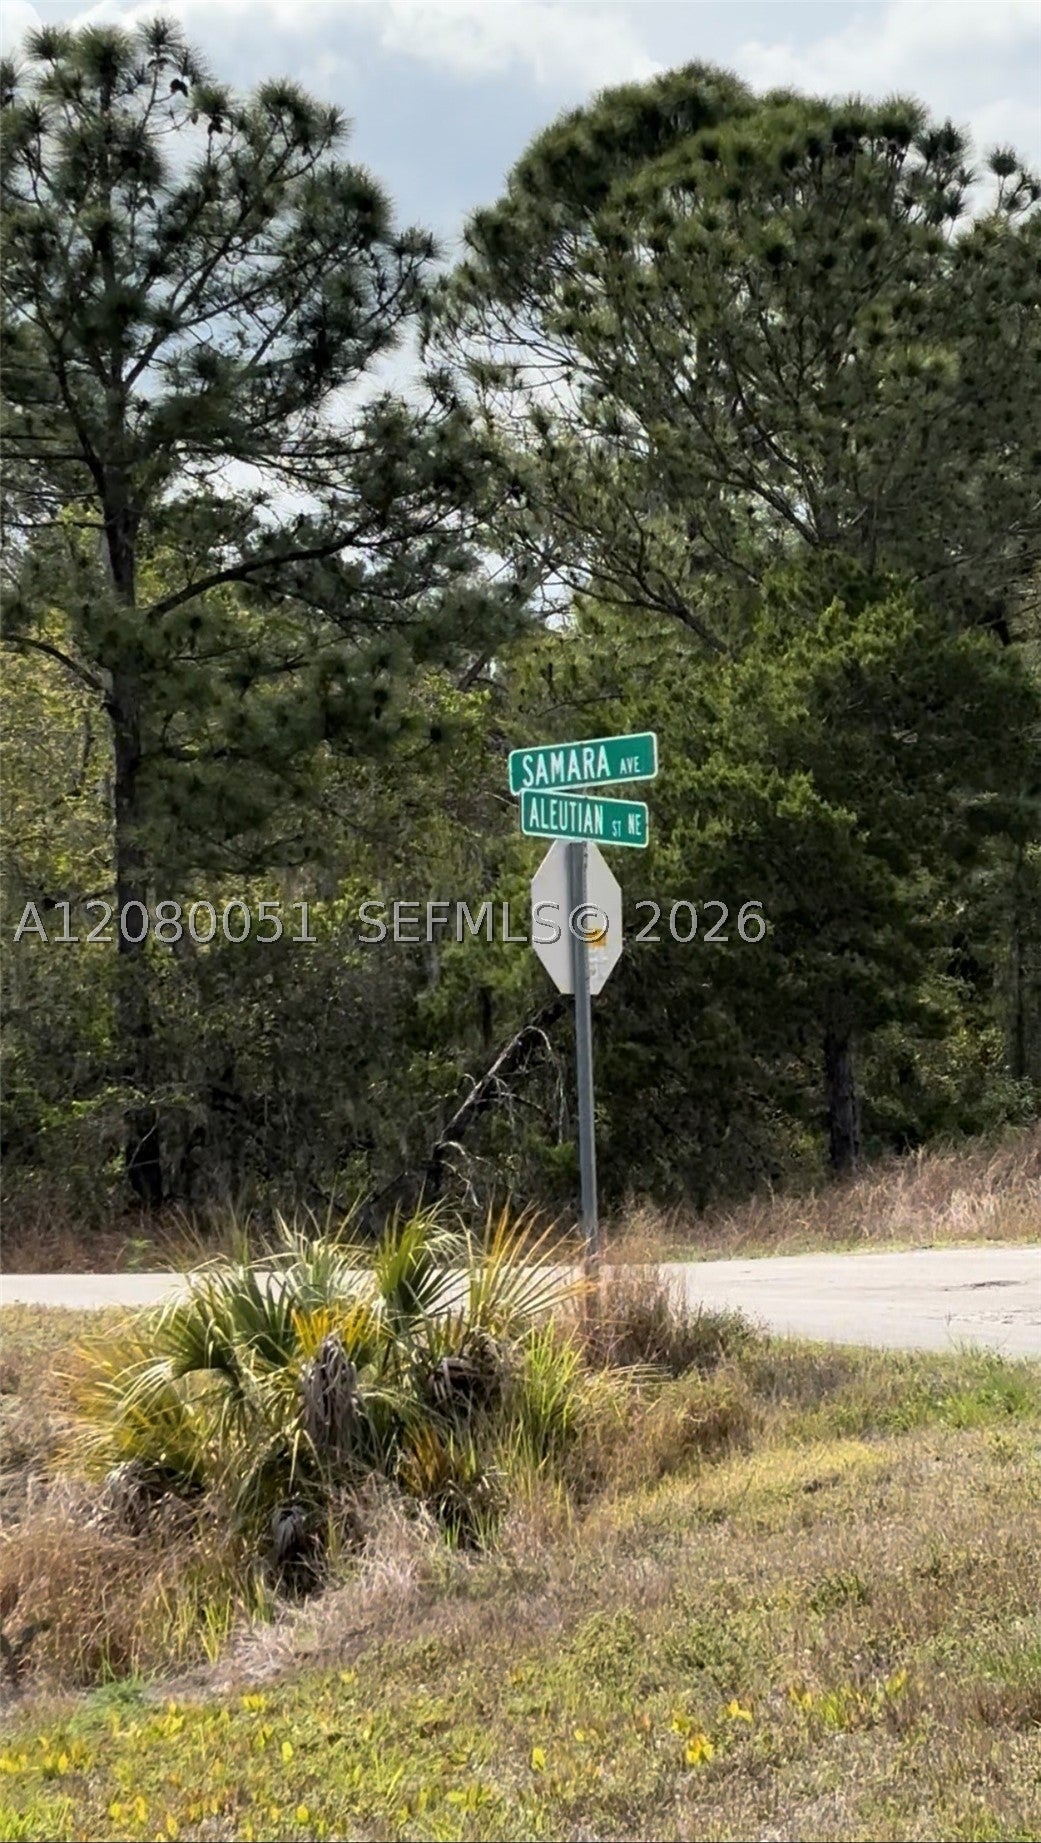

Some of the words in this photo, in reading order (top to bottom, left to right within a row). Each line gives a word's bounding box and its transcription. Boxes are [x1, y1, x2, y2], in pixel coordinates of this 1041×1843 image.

[522, 745, 611, 787] SAMARA
[619, 756, 641, 775] AVE
[529, 797, 604, 836] ALEUTIAN
[611, 820, 622, 837] ST
[628, 813, 642, 836] NE
